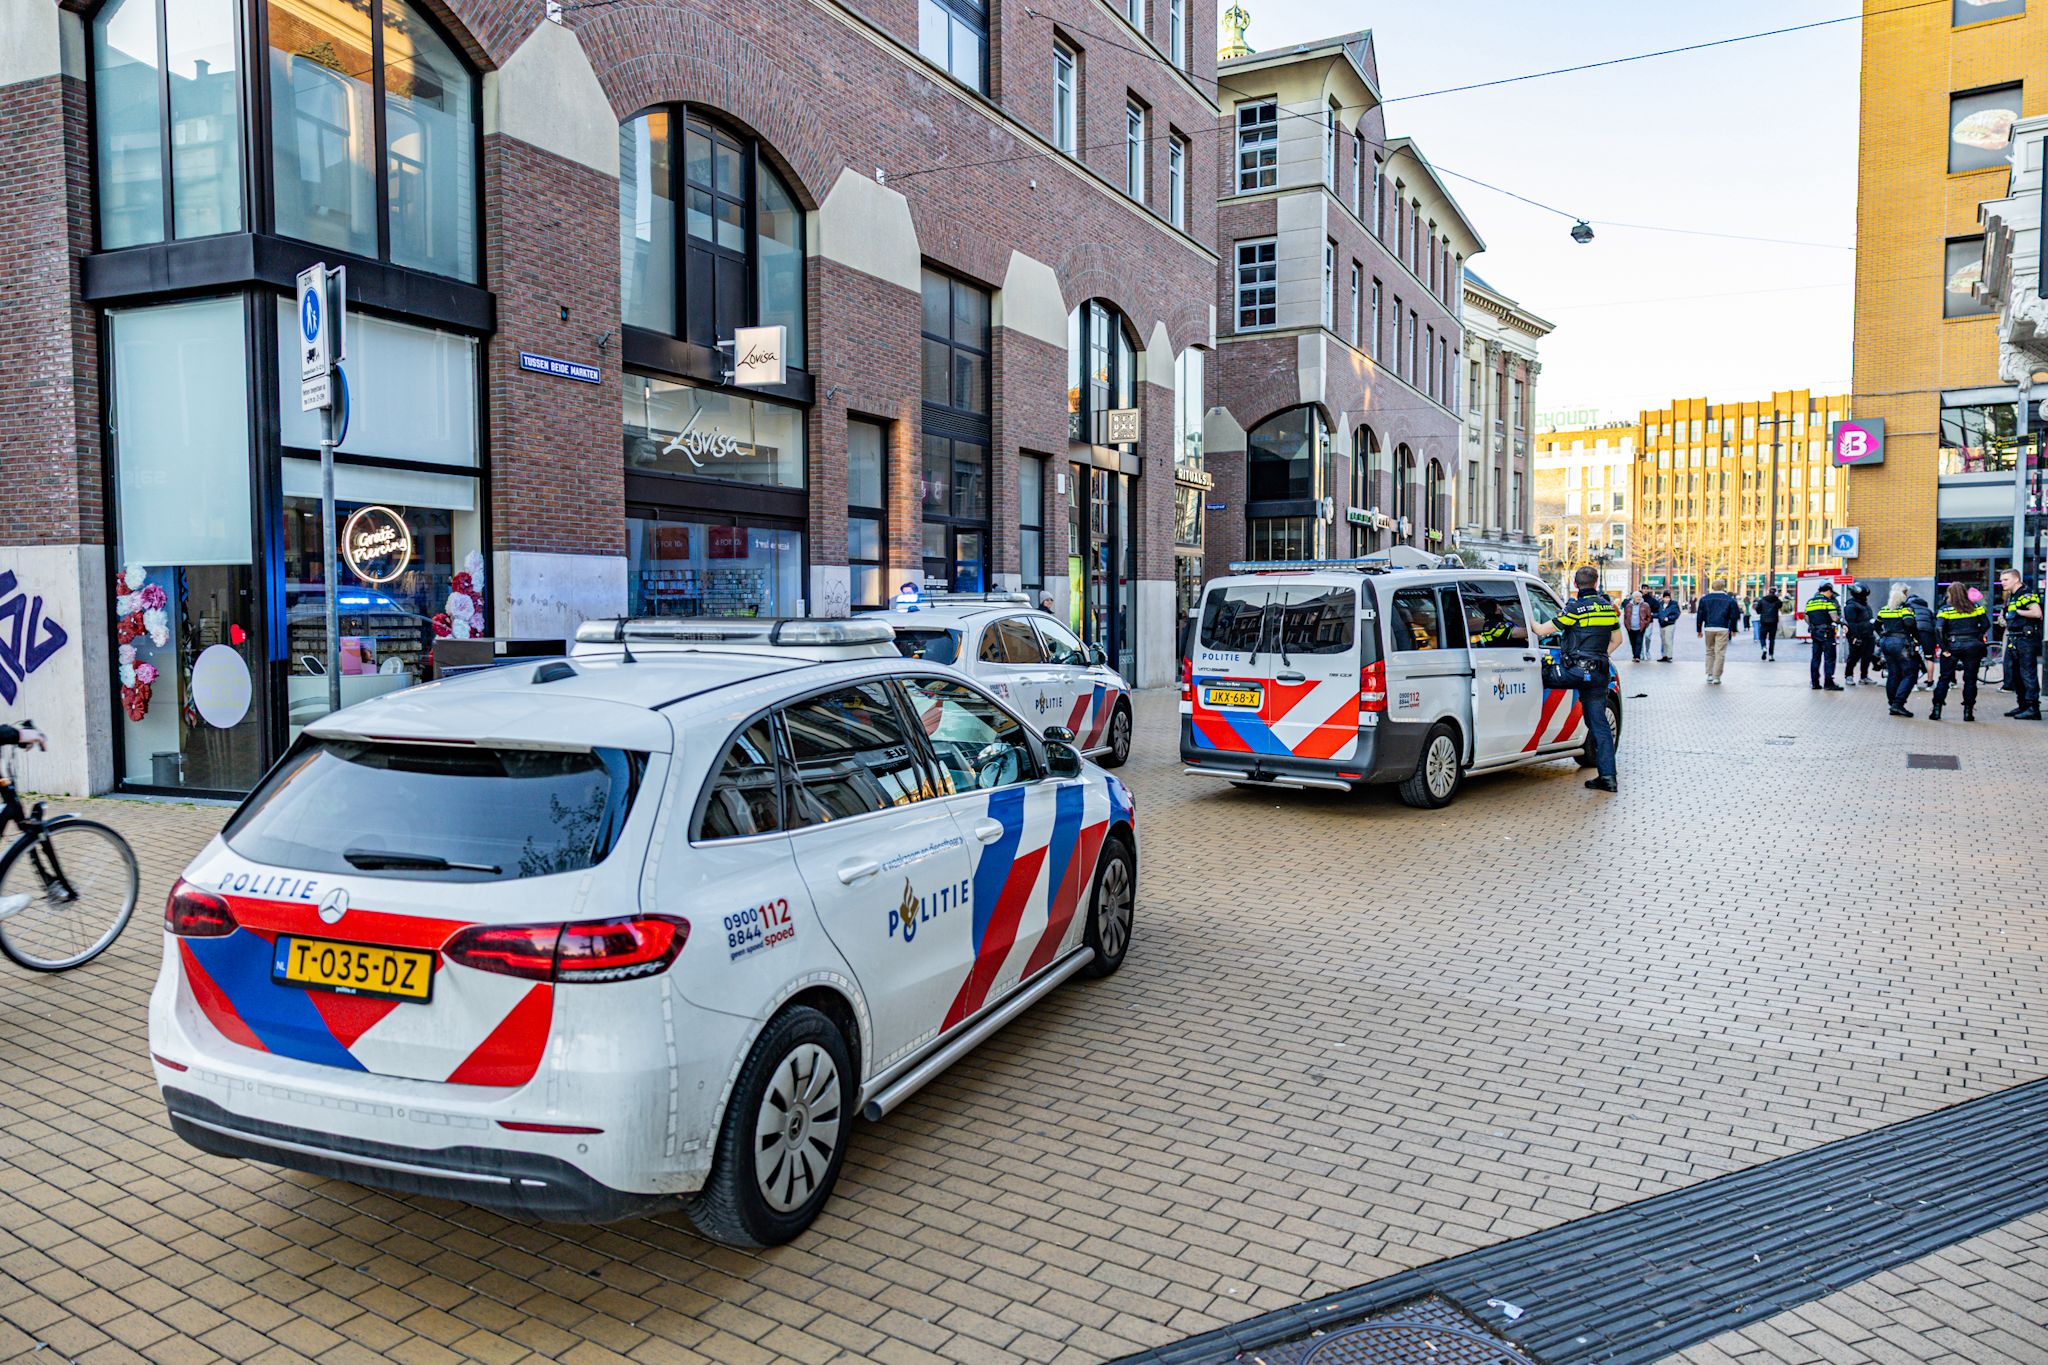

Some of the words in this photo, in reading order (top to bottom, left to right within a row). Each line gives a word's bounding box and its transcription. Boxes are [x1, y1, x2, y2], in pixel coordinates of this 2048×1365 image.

[523, 356, 549, 370] TUSSEN
[550, 361, 569, 374] BEIDE
[570, 366, 599, 380] MARKTEN
[737, 344, 779, 369] Lovisa
[662, 406, 748, 468] Lovisa
[357, 525, 396, 547] Gratis
[352, 538, 408, 563] Piercing
[1202, 653, 1241, 661] POLITIE
[1212, 692, 1256, 704] JKX-68-X
[1409, 692, 1420, 702] 112
[218, 872, 318, 899] POLITIE
[724, 908, 758, 931] 0900
[759, 898, 791, 929] 112
[889, 879, 969, 943] POLITIE
[728, 924, 762, 948] 8844
[764, 923, 795, 948] spoed
[275, 960, 286, 971] NL
[296, 944, 418, 990] T-035-DZ
